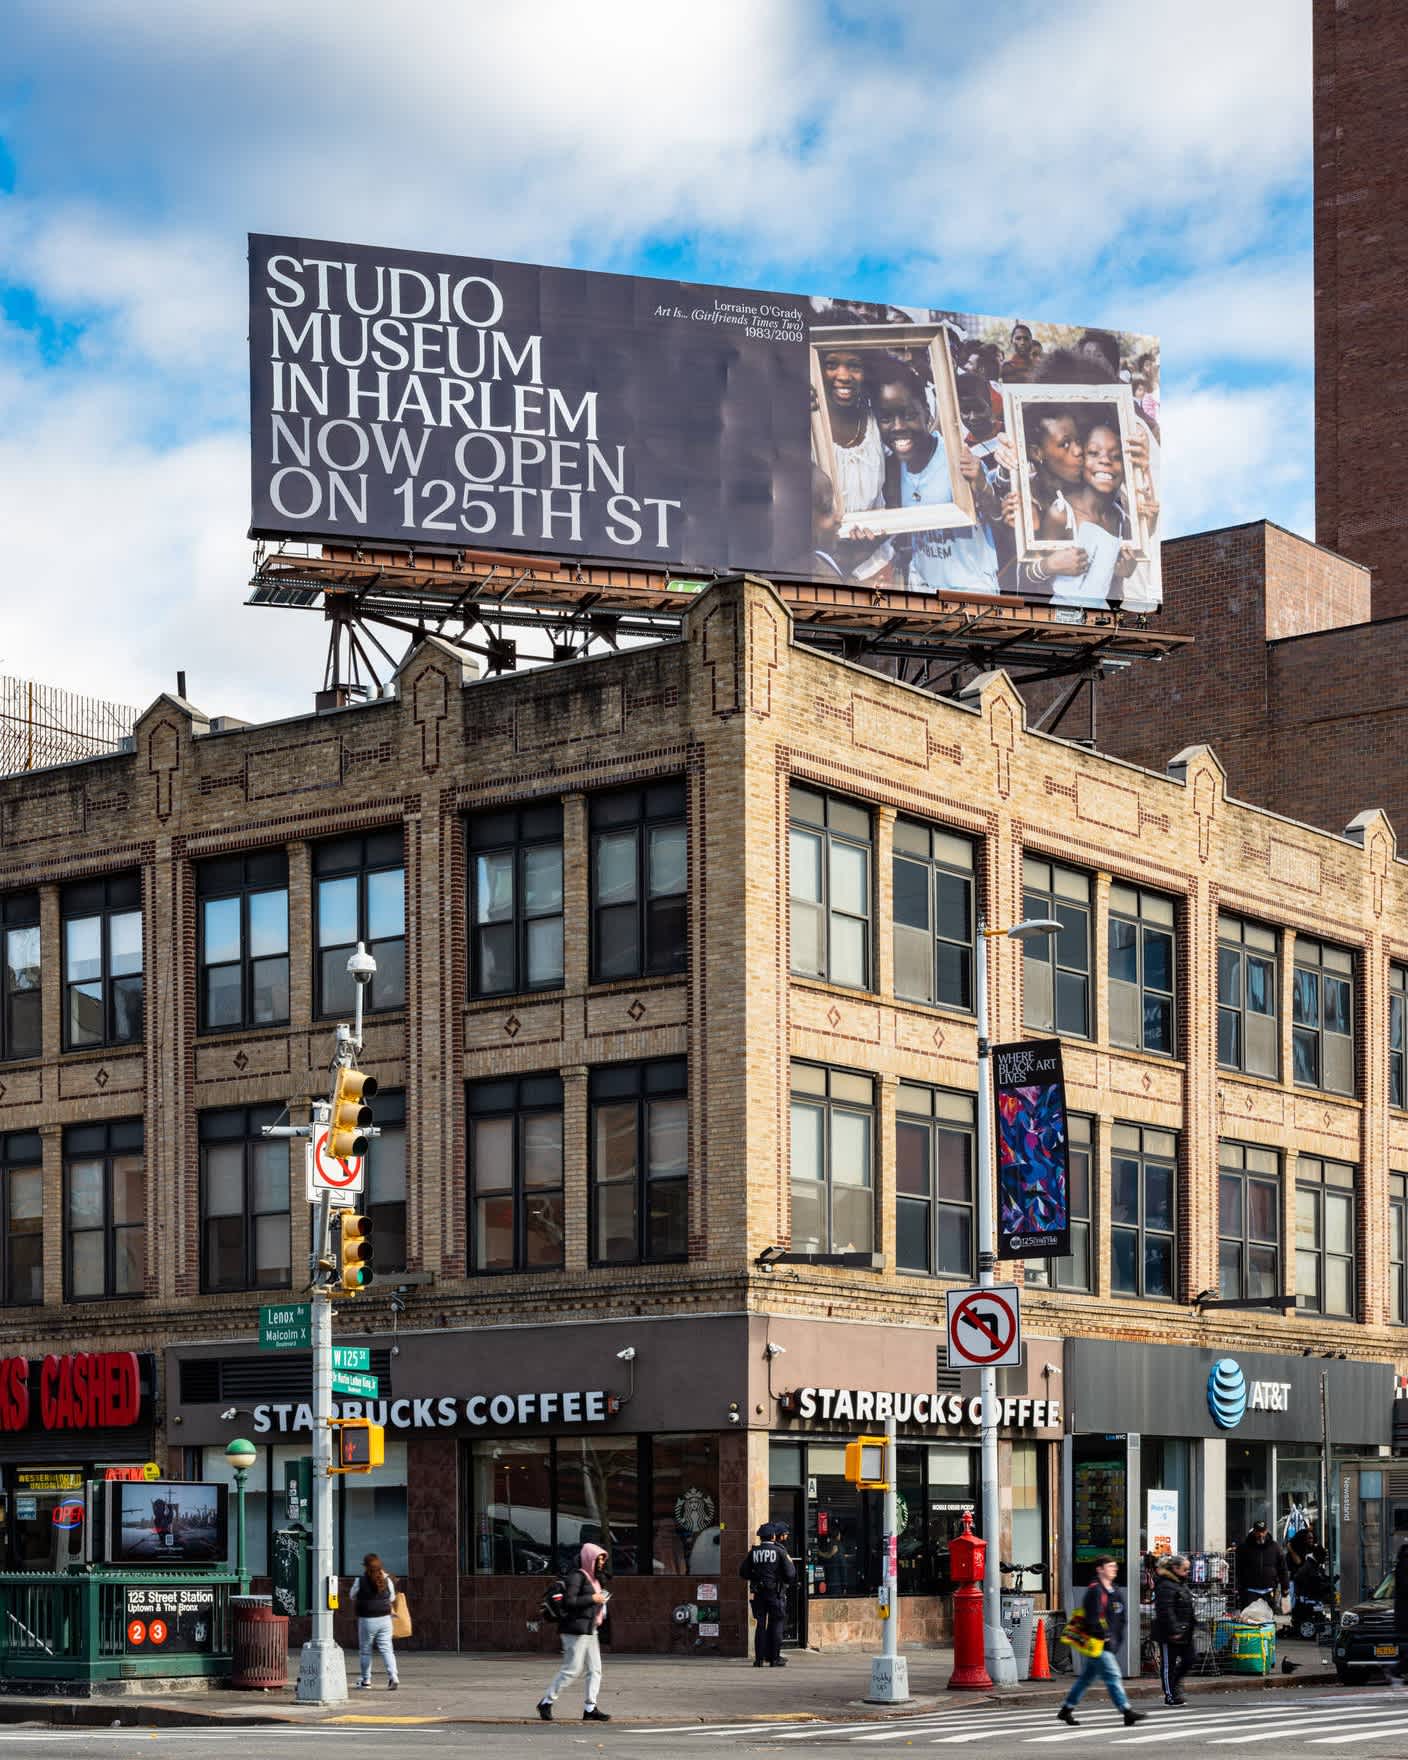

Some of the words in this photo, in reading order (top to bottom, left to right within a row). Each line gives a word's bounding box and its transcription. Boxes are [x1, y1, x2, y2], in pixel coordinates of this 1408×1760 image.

[266, 255, 504, 328] STUDIO
[654, 305, 671, 317] Art
[691, 309, 749, 325] (Girlfriends
[751, 315, 778, 329] Times
[782, 319, 804, 332] Two)
[714, 299, 757, 315] Lorraine
[760, 305, 803, 321] O'Grady
[745, 327, 803, 342] 1983/2009
[270, 307, 543, 384] MUSEUM
[270, 361, 329, 415] IN
[348, 368, 598, 440] HARLEM
[270, 414, 432, 477] NOW
[455, 432, 625, 495] OPEN
[269, 466, 368, 524] ON
[393, 477, 582, 541] 125TH
[605, 495, 681, 547] ST
[998, 1050, 1035, 1064] WHERE
[999, 1060, 1034, 1075] BLACK
[1036, 1058, 1057, 1071] ART
[999, 1072, 1026, 1085] LIVES
[268, 1308, 294, 1325] Lenox
[266, 1329, 298, 1342] Malcolm
[301, 1328, 306, 1339] X
[334, 1350, 341, 1367] W
[343, 1350, 358, 1367] 125
[41, 1351, 140, 1430] CASHED
[1248, 1381, 1291, 1411] AT&T
[465, 1391, 605, 1425] COFFEE
[799, 1388, 962, 1424] STARBUCKS
[808, 1481, 816, 1493] A
[753, 1549, 777, 1563] NYPD
[127, 1591, 145, 1604] 125
[148, 1591, 178, 1603] Street
[180, 1591, 213, 1603] Station
[127, 1603, 154, 1615] Uptown
[155, 1603, 161, 1612] &
[163, 1603, 177, 1612] The
[178, 1603, 199, 1612] Bronx
[133, 1625, 142, 1640] 2
[153, 1624, 163, 1639] 3
